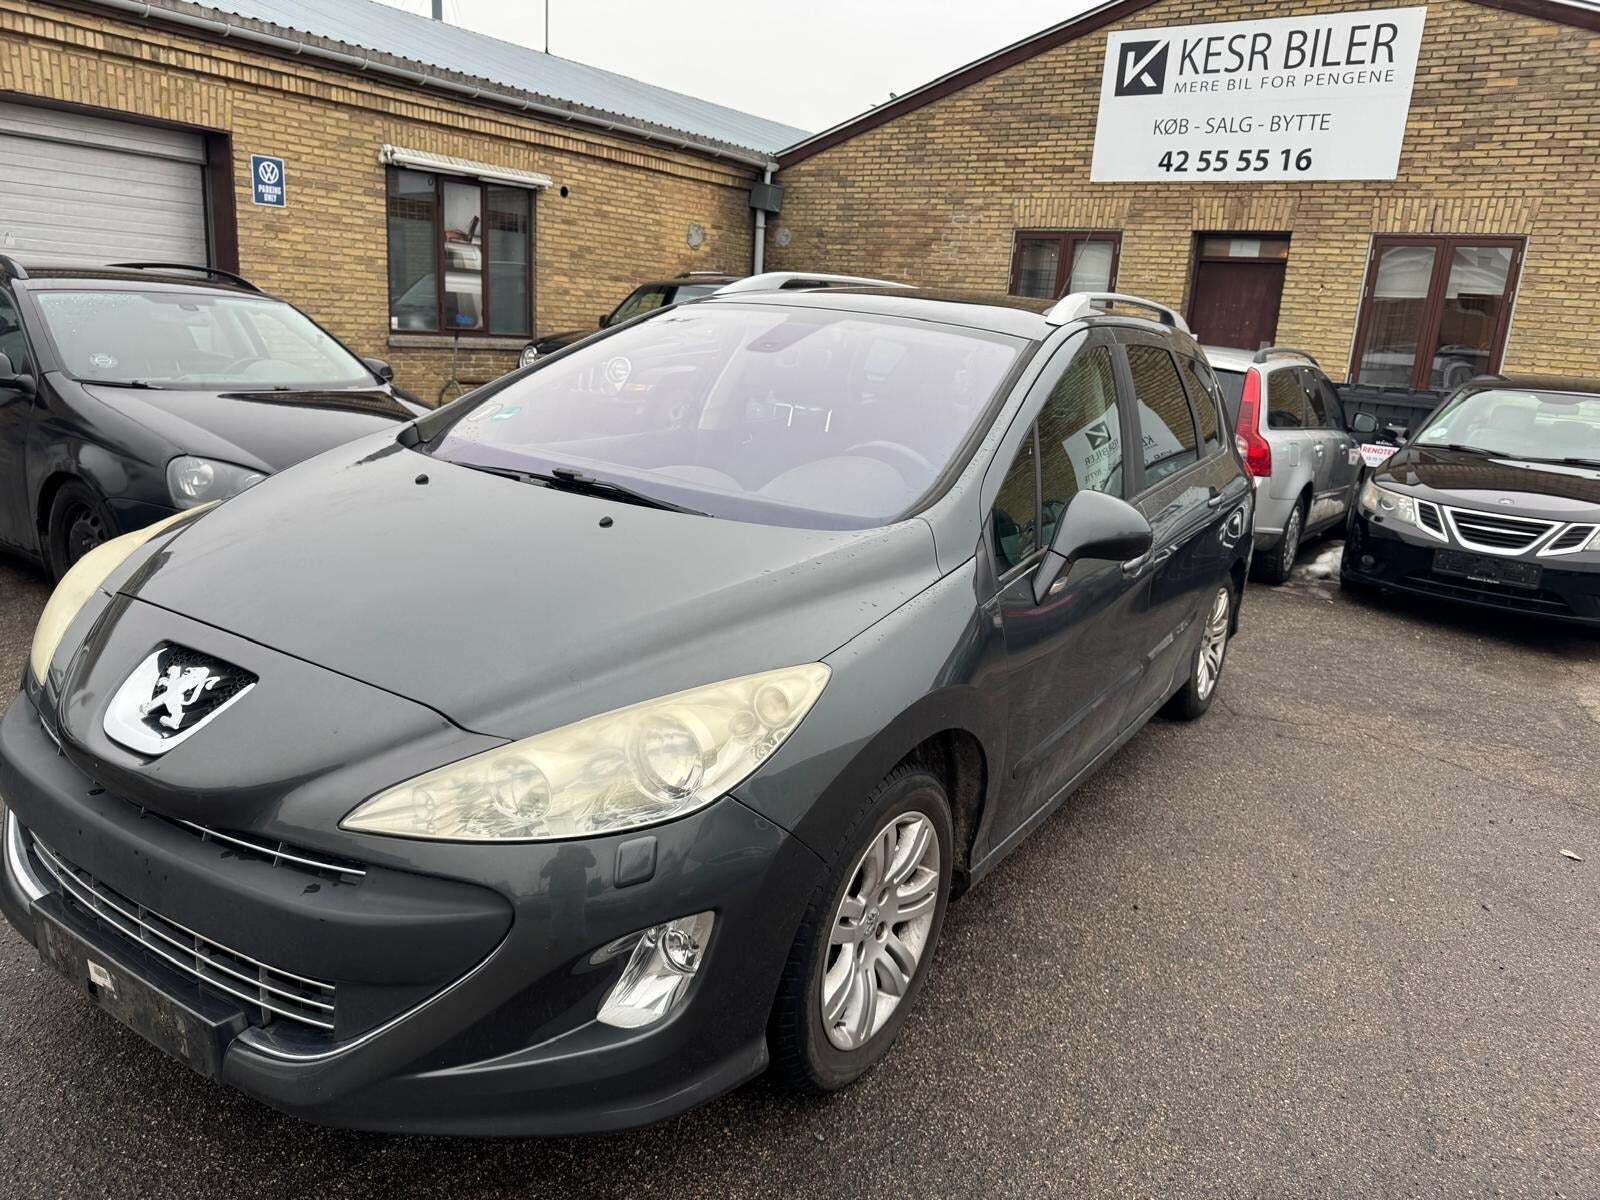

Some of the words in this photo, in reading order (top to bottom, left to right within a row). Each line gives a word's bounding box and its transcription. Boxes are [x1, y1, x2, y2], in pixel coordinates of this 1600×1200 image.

[1179, 33, 1272, 76] KESR
[1283, 22, 1398, 70] BILER
[1174, 80, 1220, 94] MERE
[1226, 78, 1253, 91] BIL
[1260, 75, 1296, 89] FOR
[1303, 69, 1396, 87] PENGENE
[1153, 117, 1190, 136] KØB
[1204, 116, 1253, 135] SALG
[1269, 113, 1332, 132] BYTTE
[1158, 150, 1190, 172] 42
[1196, 149, 1229, 172] 55
[1235, 149, 1270, 172] 55
[1280, 148, 1313, 172] 16
